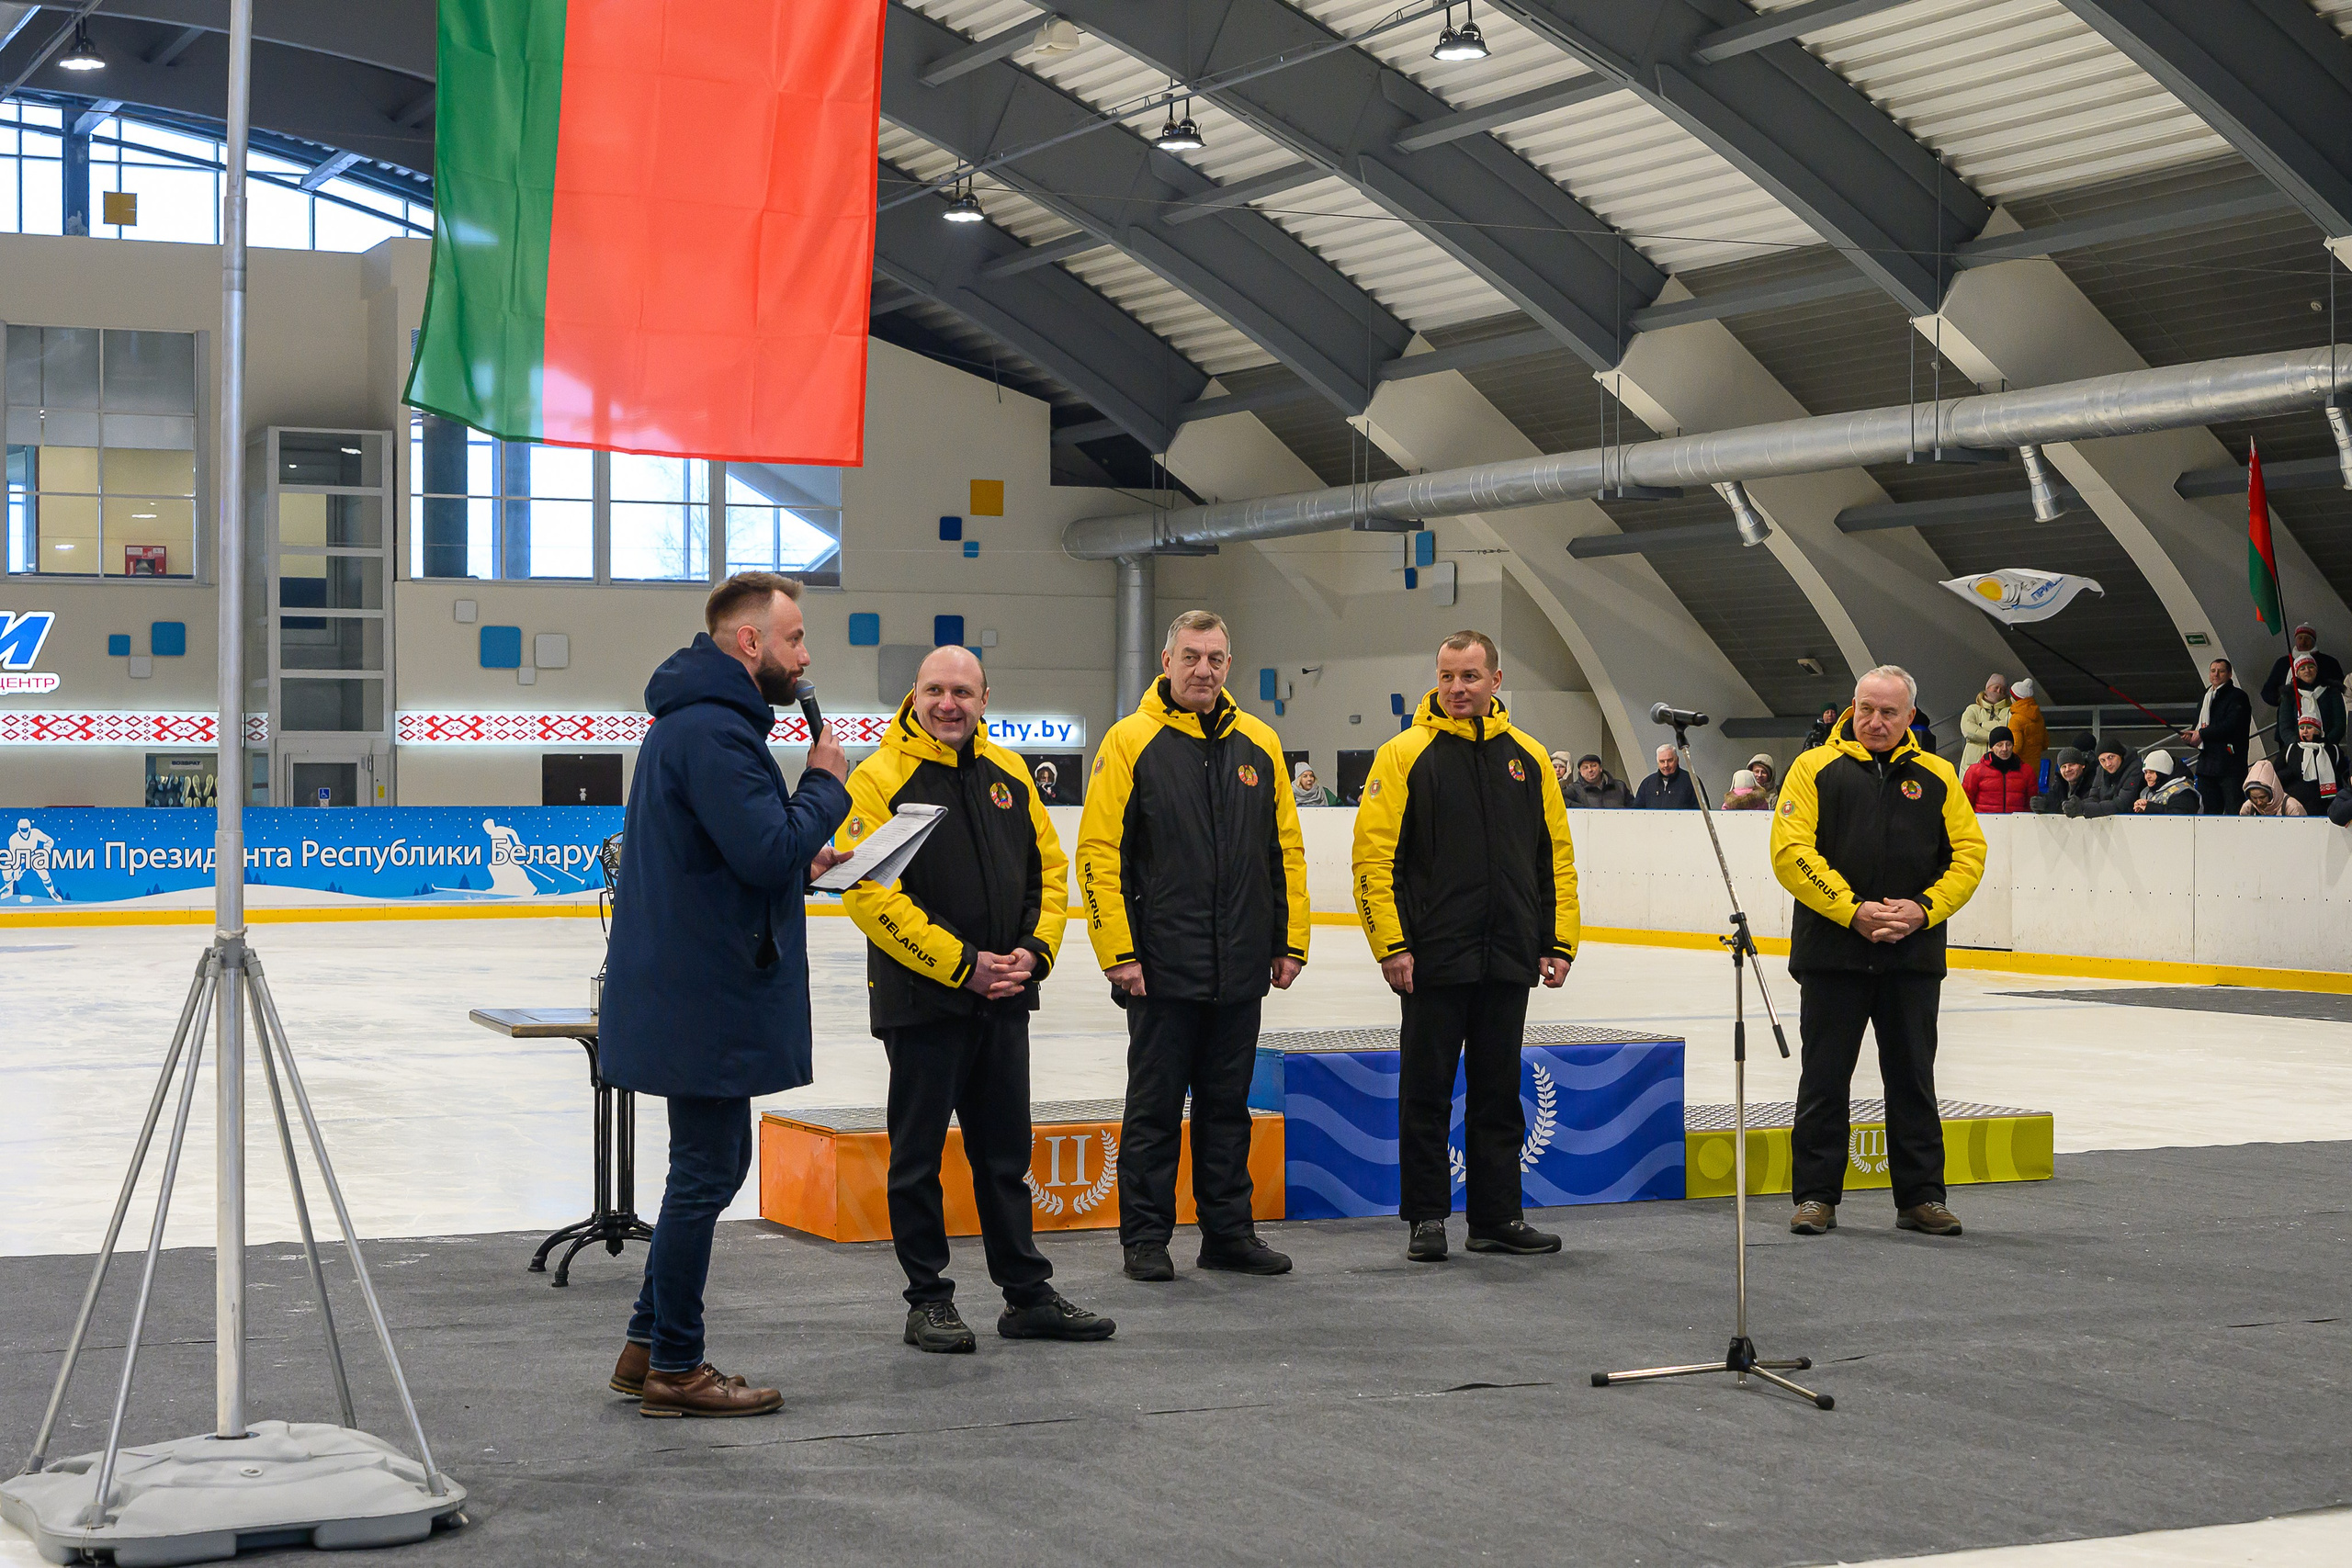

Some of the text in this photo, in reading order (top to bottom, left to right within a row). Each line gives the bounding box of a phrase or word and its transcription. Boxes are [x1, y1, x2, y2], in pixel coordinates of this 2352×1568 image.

[0, 838, 604, 876] елами Президнта Республики Белару
[1795, 856, 1838, 901] BELARUS
[1084, 862, 1102, 931] BELARUS
[1360, 874, 1376, 934] BELARUS
[877, 913, 938, 968] BELARUS
[1044, 1134, 1092, 1187] II
